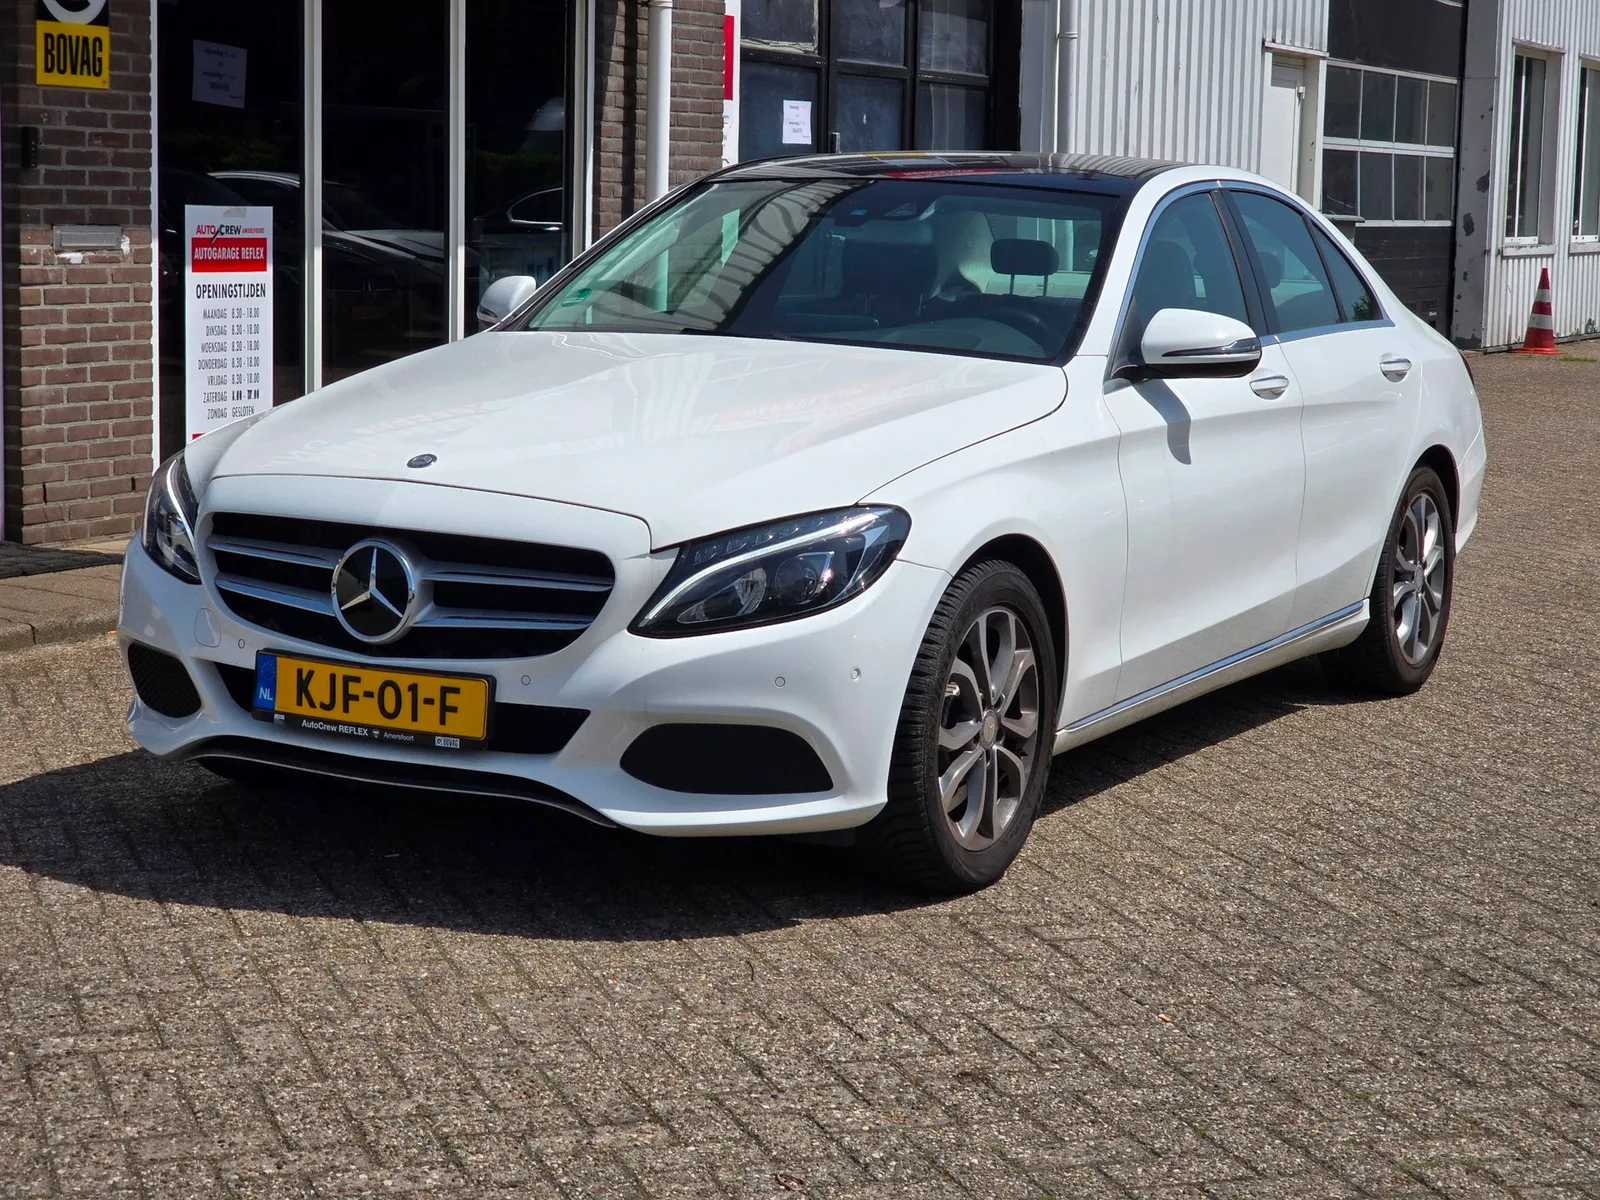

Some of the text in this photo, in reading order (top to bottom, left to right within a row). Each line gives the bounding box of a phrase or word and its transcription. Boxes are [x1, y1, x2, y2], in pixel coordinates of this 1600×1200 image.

[43, 32, 103, 78] BOVAG
[194, 246, 265, 260] AUTOGARAGE REFLEX
[195, 283, 266, 299] OPENINGSTIJDEN
[202, 308, 227, 319] MAANDAG
[231, 308, 242, 319] 8.30
[246, 307, 260, 318] 18.00
[206, 325, 227, 336] DINSDAG
[231, 324, 242, 335] 8.30
[246, 323, 260, 335] 18.00
[201, 341, 227, 353] WOENSDAG
[231, 340, 242, 352] 8.30
[246, 340, 260, 351] 18.00
[198, 358, 227, 370] DONDERDAG
[231, 357, 242, 368] 8.30
[246, 356, 260, 367] 18.00
[207, 374, 227, 386] VRIJDAG
[231, 373, 242, 384] 8.30
[246, 372, 260, 383] 18.00
[203, 391, 227, 403] ZATERDAG
[207, 405, 255, 419] ZONDAG GESLOTEN
[258, 686, 273, 701] NL
[295, 667, 461, 726] KJF-01-F
[301, 719, 369, 737] AutoCrew REFLEX
[383, 731, 414, 742] Amersfoort
